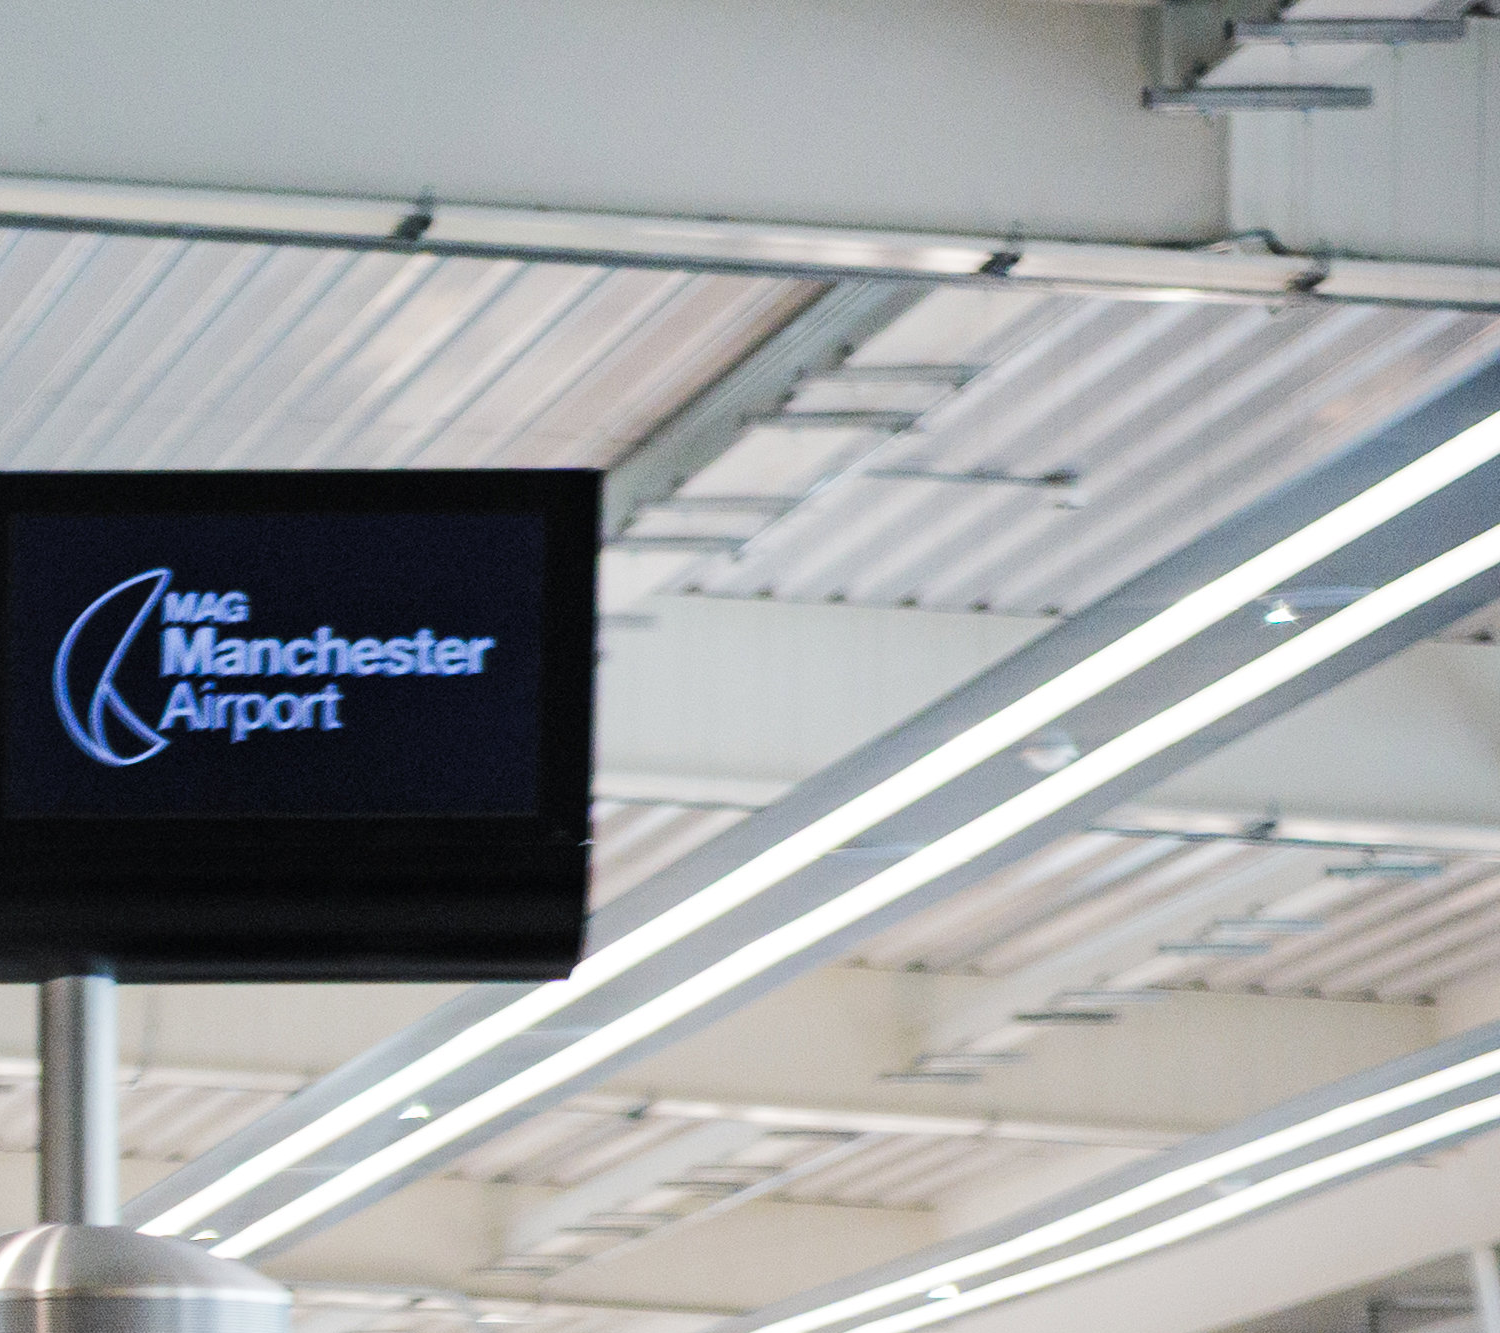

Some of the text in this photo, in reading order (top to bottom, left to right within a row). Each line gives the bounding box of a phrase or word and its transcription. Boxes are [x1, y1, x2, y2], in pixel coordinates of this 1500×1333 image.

[162, 591, 250, 624] MAG
[161, 626, 495, 677] Manchester
[160, 684, 344, 742] Airport
